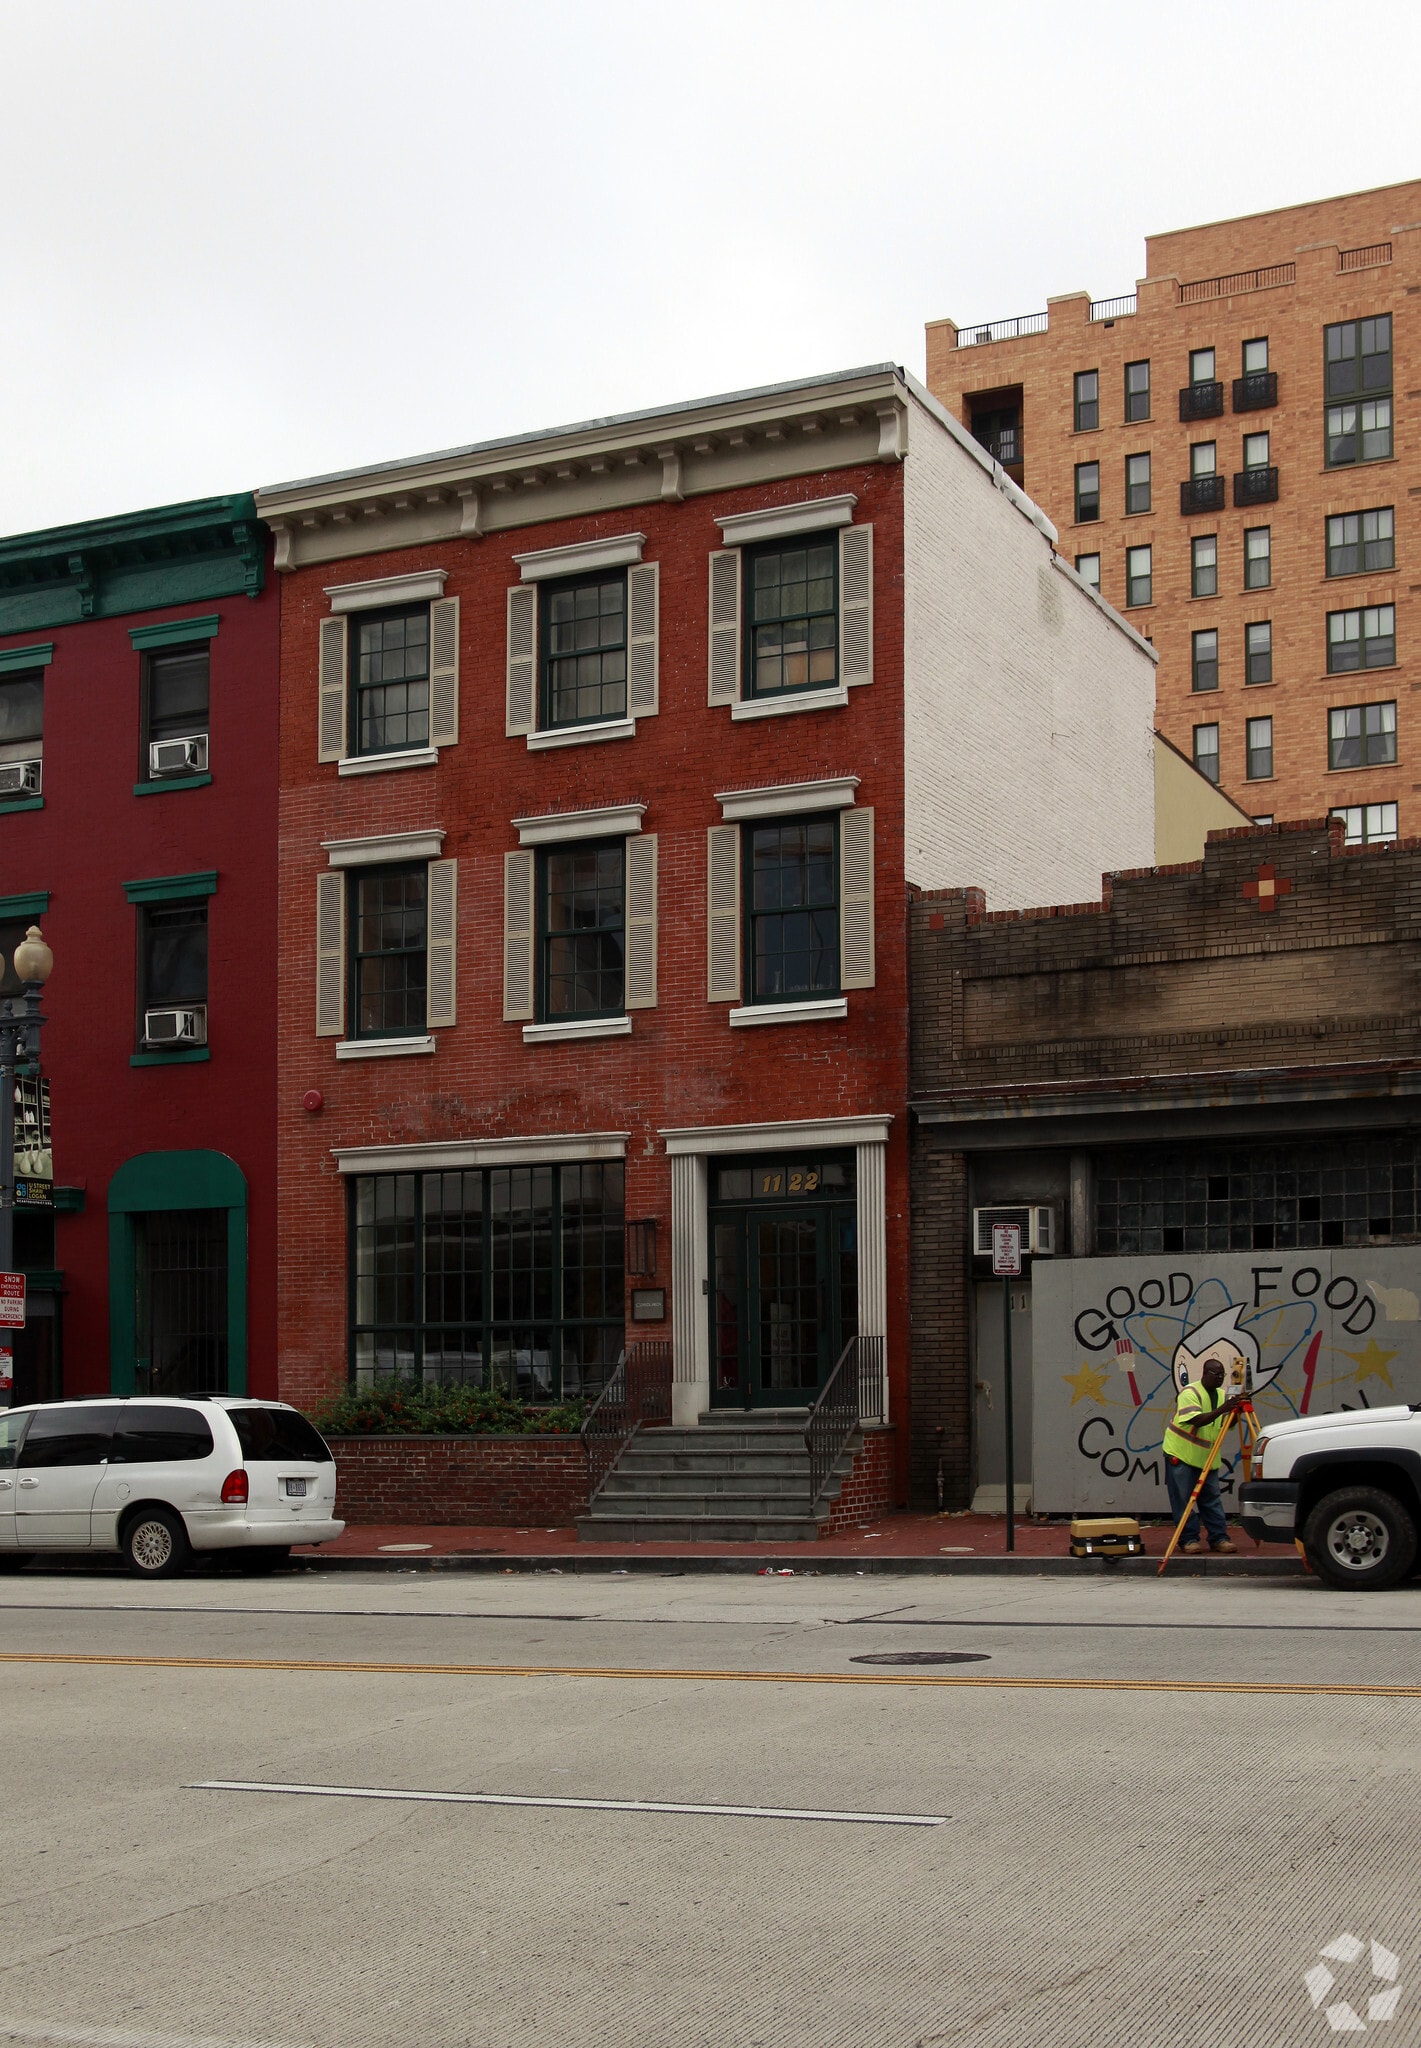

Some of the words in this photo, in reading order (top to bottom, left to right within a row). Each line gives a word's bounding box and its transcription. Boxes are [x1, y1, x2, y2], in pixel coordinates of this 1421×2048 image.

[4, 1275, 20, 1283] SNOW
[3, 1289, 20, 1297] ROUTE
[1074, 1271, 1194, 1352] GOOD
[1251, 1266, 1377, 1336] FOOD
